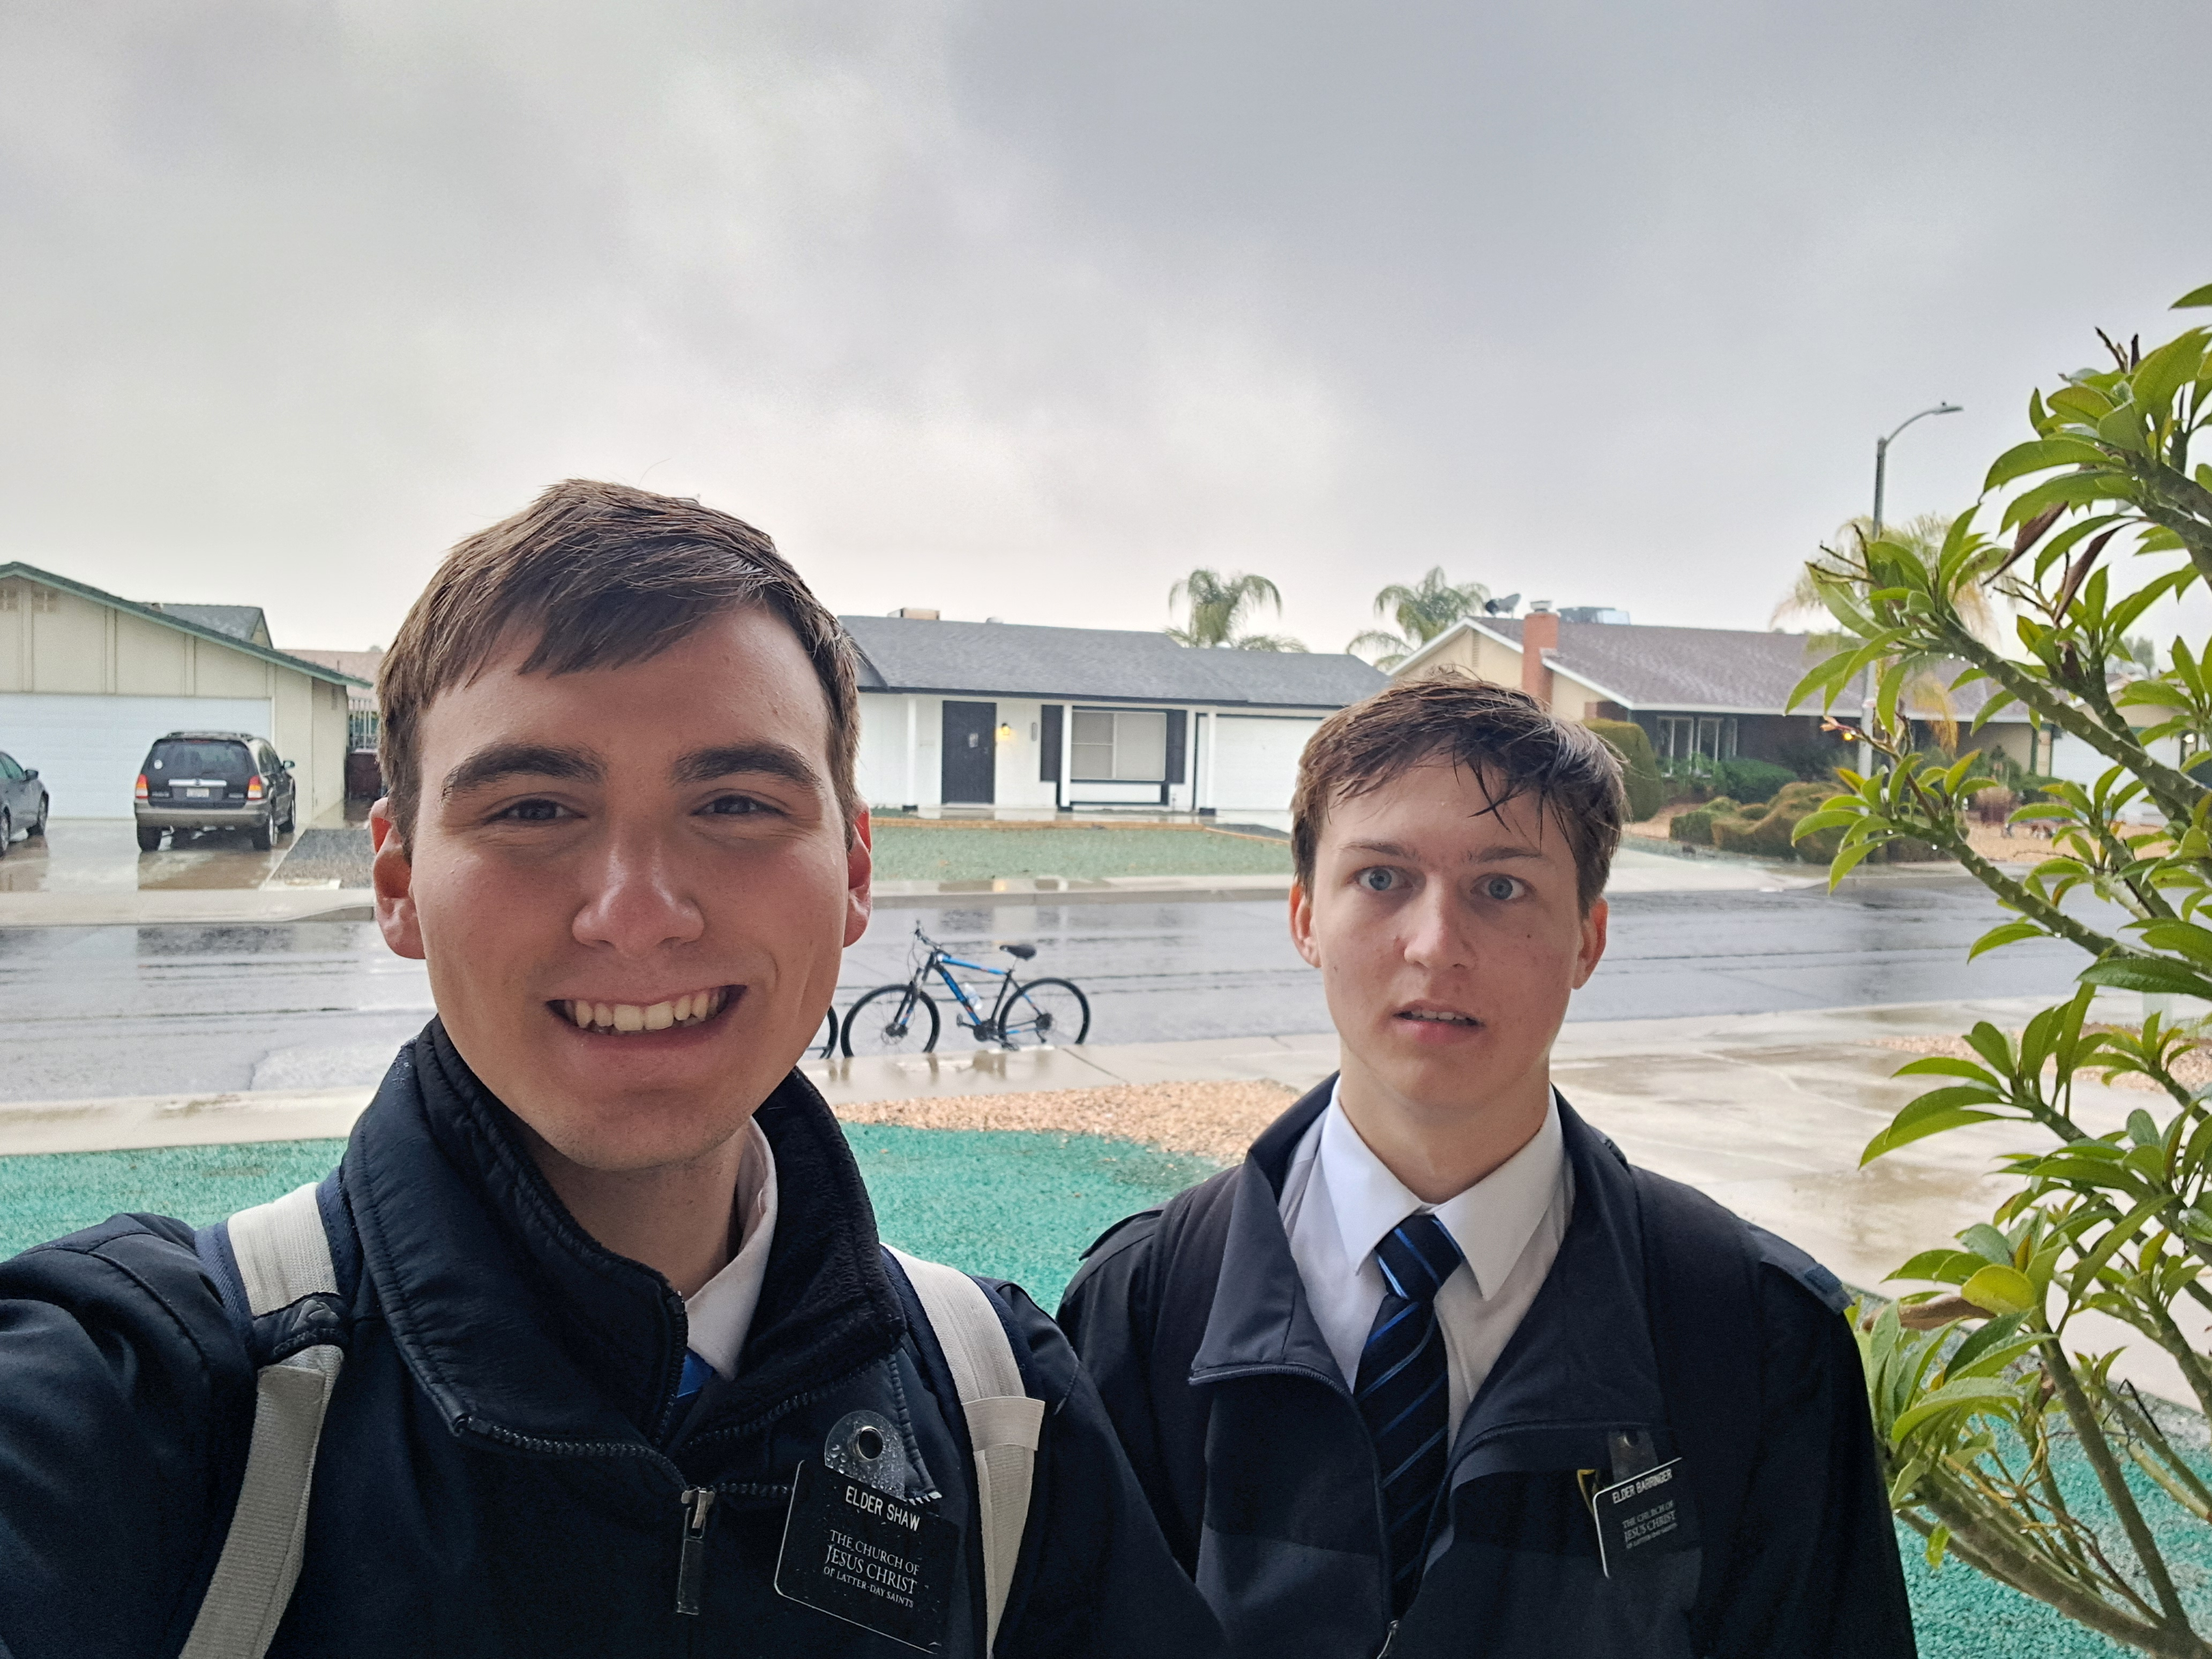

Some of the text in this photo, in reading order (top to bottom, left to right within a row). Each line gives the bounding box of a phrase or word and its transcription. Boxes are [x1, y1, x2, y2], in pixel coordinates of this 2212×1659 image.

[845, 1485, 920, 1531] ELDER SHAW
[1612, 1485, 1635, 1504] ELDER
[825, 1544, 918, 1595] JESUS CHRIST
[830, 1529, 920, 1575] THE CHURCH OF
[824, 1566, 914, 1608] OF LATTER-DAY SAINTS
